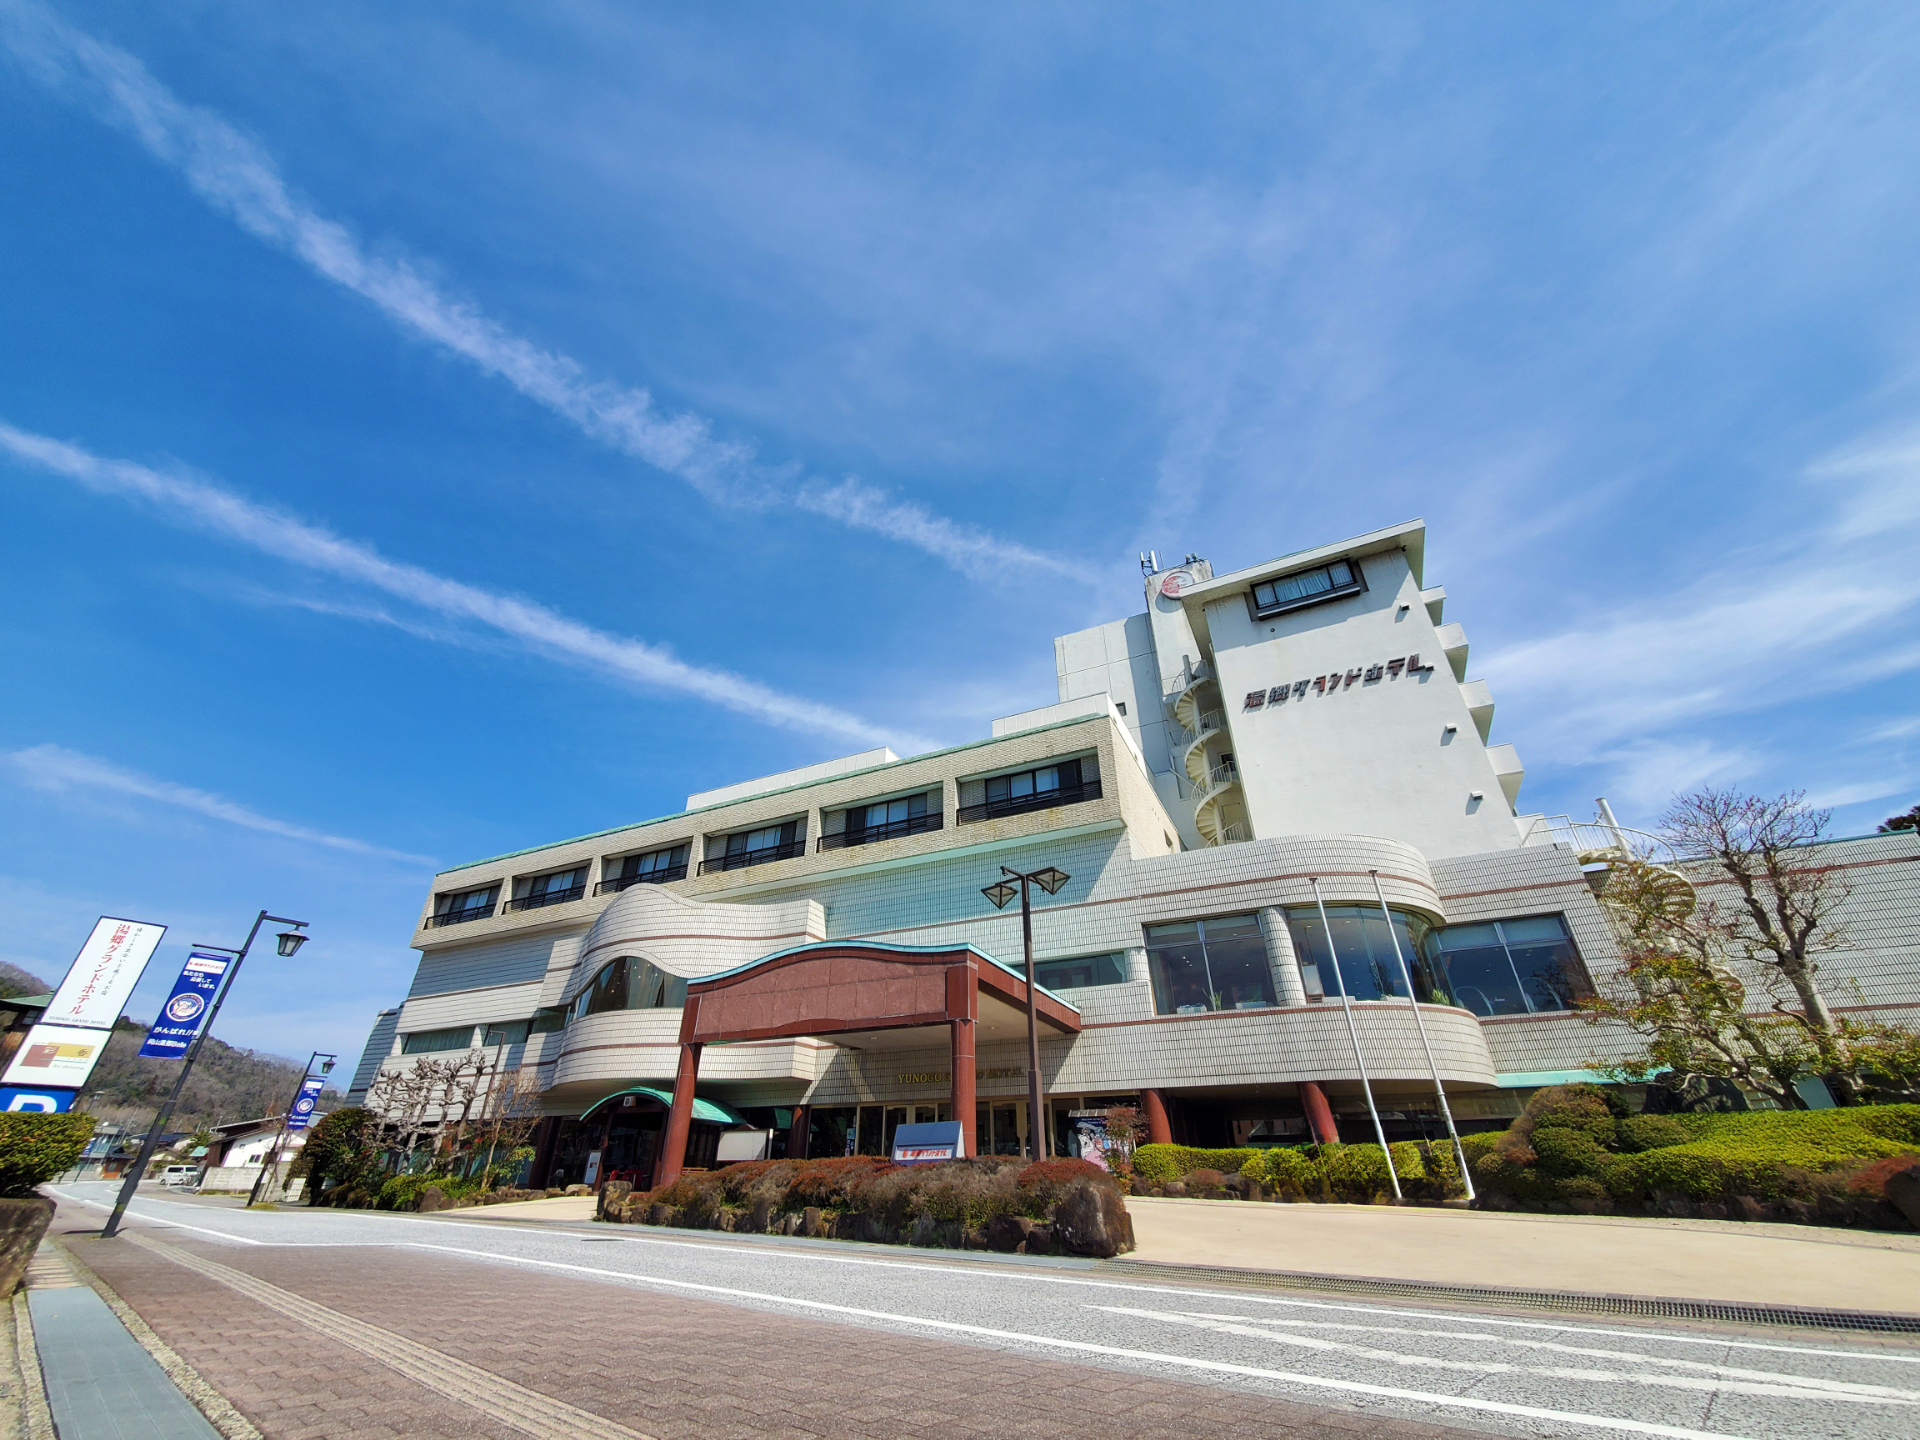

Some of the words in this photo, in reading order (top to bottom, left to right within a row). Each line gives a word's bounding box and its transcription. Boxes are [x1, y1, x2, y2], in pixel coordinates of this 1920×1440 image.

[1243, 653, 1424, 708] 湯郷グランドホテル
[68, 923, 131, 1015] 湯郷グランドホテル
[898, 1073, 942, 1083] YUNOGO
